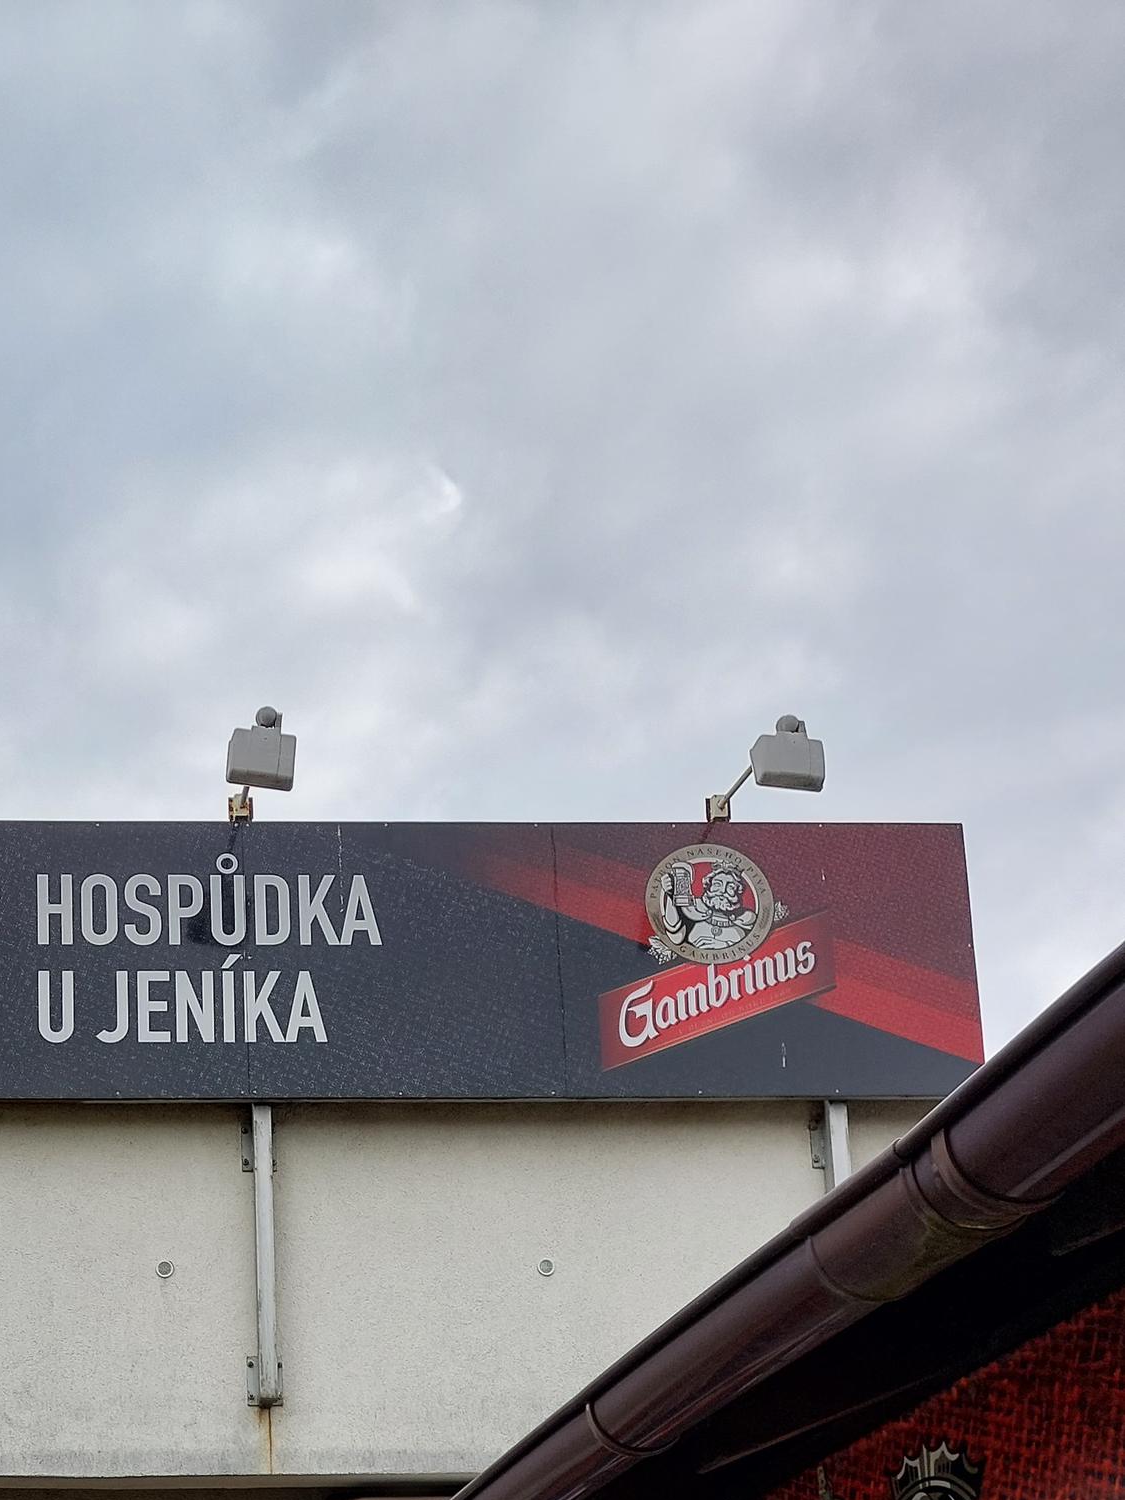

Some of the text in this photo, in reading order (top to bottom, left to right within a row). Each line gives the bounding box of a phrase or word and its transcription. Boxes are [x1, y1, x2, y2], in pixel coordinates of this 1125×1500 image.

[36, 853, 383, 946] HOSPŮDKA
[745, 866, 766, 894] PIVA
[679, 933, 760, 960] GAMBRINUS
[37, 953, 328, 1044] U JENÍKA
[618, 940, 816, 1048] Gambrinus
